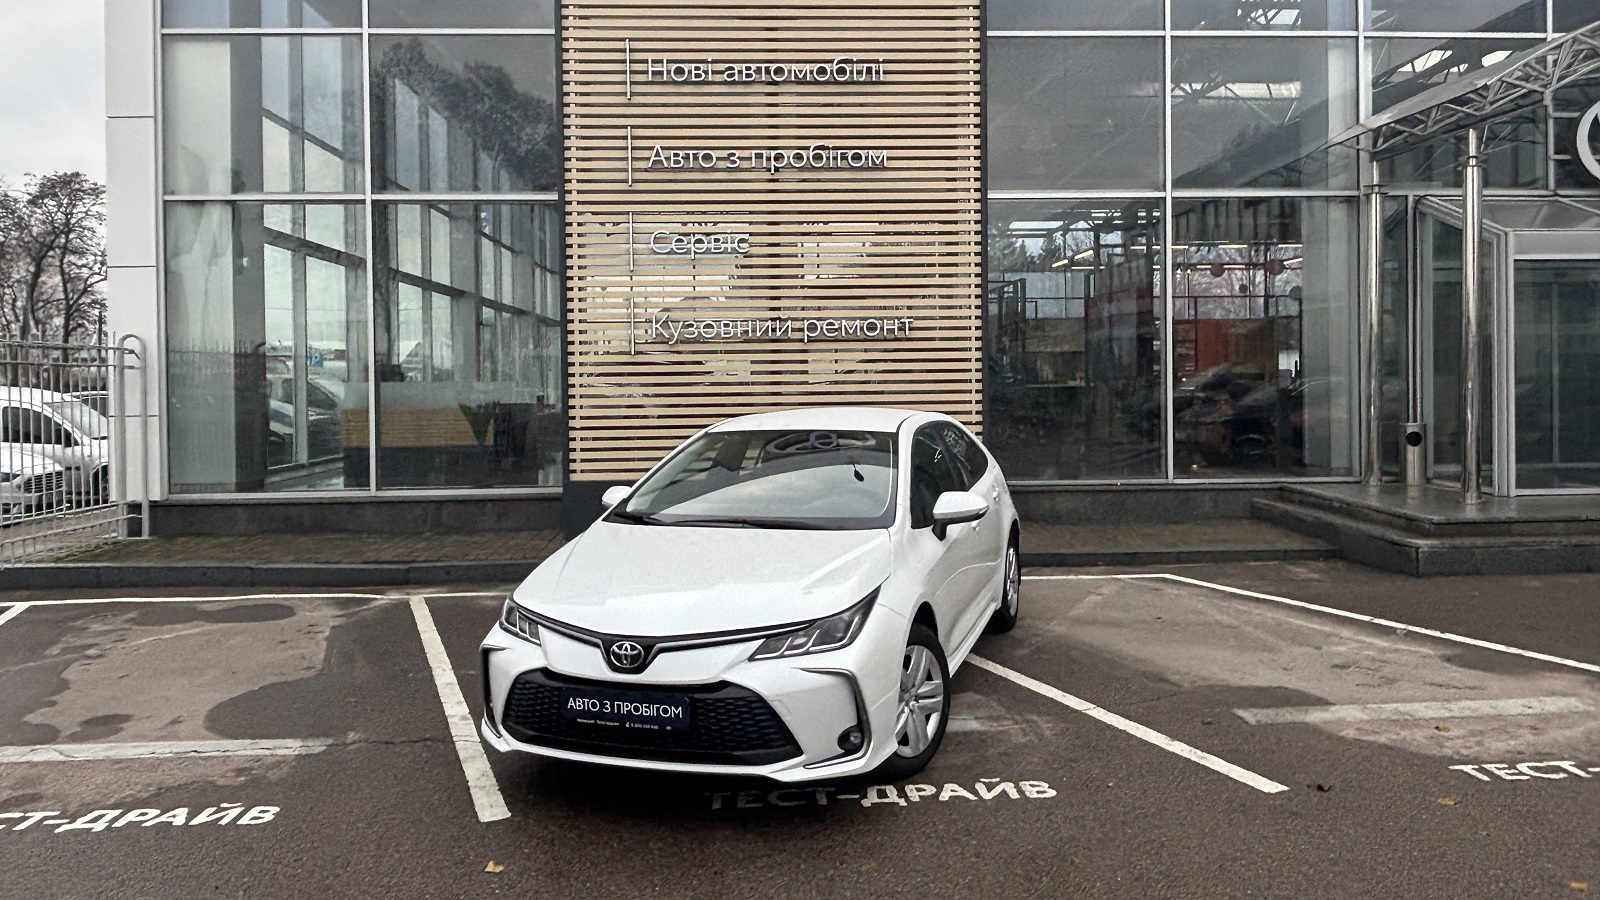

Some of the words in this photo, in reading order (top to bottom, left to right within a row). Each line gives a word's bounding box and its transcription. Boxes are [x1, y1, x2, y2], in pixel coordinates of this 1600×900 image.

[647, 57, 713, 83] Нові
[723, 56, 885, 84] автомобілі
[647, 144, 718, 169] Авто
[726, 151, 741, 169] з
[751, 142, 888, 175] пробігом
[649, 230, 750, 260] Сервіс
[651, 313, 793, 345] Кузовний
[803, 316, 914, 344] ремонт
[567, 697, 600, 712] АВТО
[614, 701, 683, 719] ПРОБІГОМ
[704, 777, 1058, 810] ТЕСТ-ДРАЙВ
